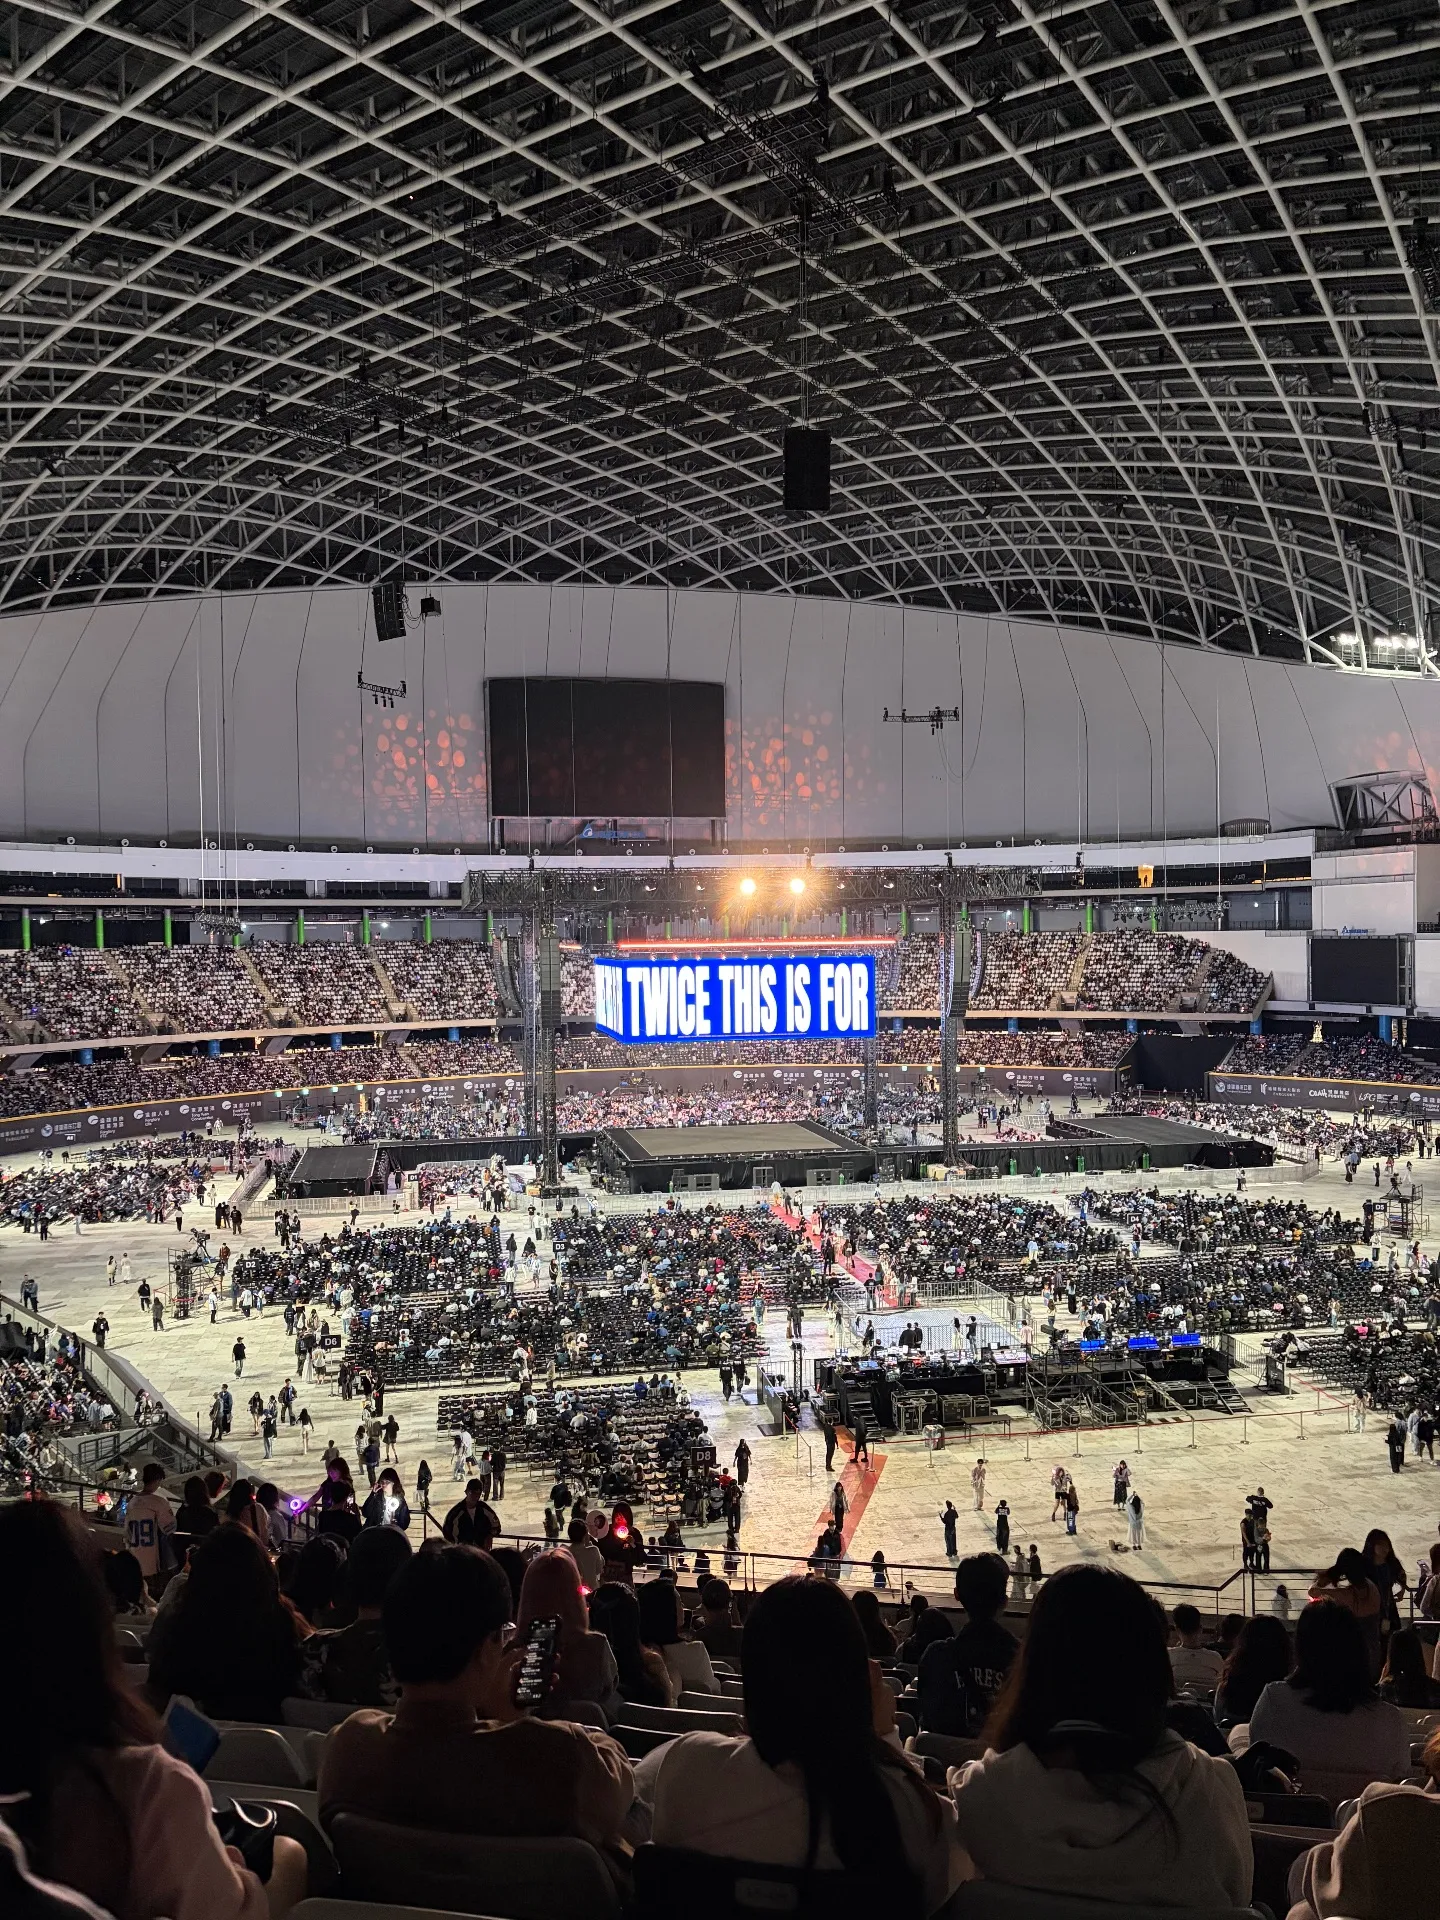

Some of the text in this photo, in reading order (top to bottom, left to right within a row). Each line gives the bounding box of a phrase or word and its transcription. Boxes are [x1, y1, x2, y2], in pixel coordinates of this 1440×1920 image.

[626, 965, 711, 1037] TWICE
[718, 963, 778, 1034] THIS
[785, 963, 811, 1033] IS
[819, 962, 869, 1032] FOR
[325, 1338, 338, 1346] D6
[696, 1451, 711, 1461] D8
[128, 1519, 154, 1547] 09
